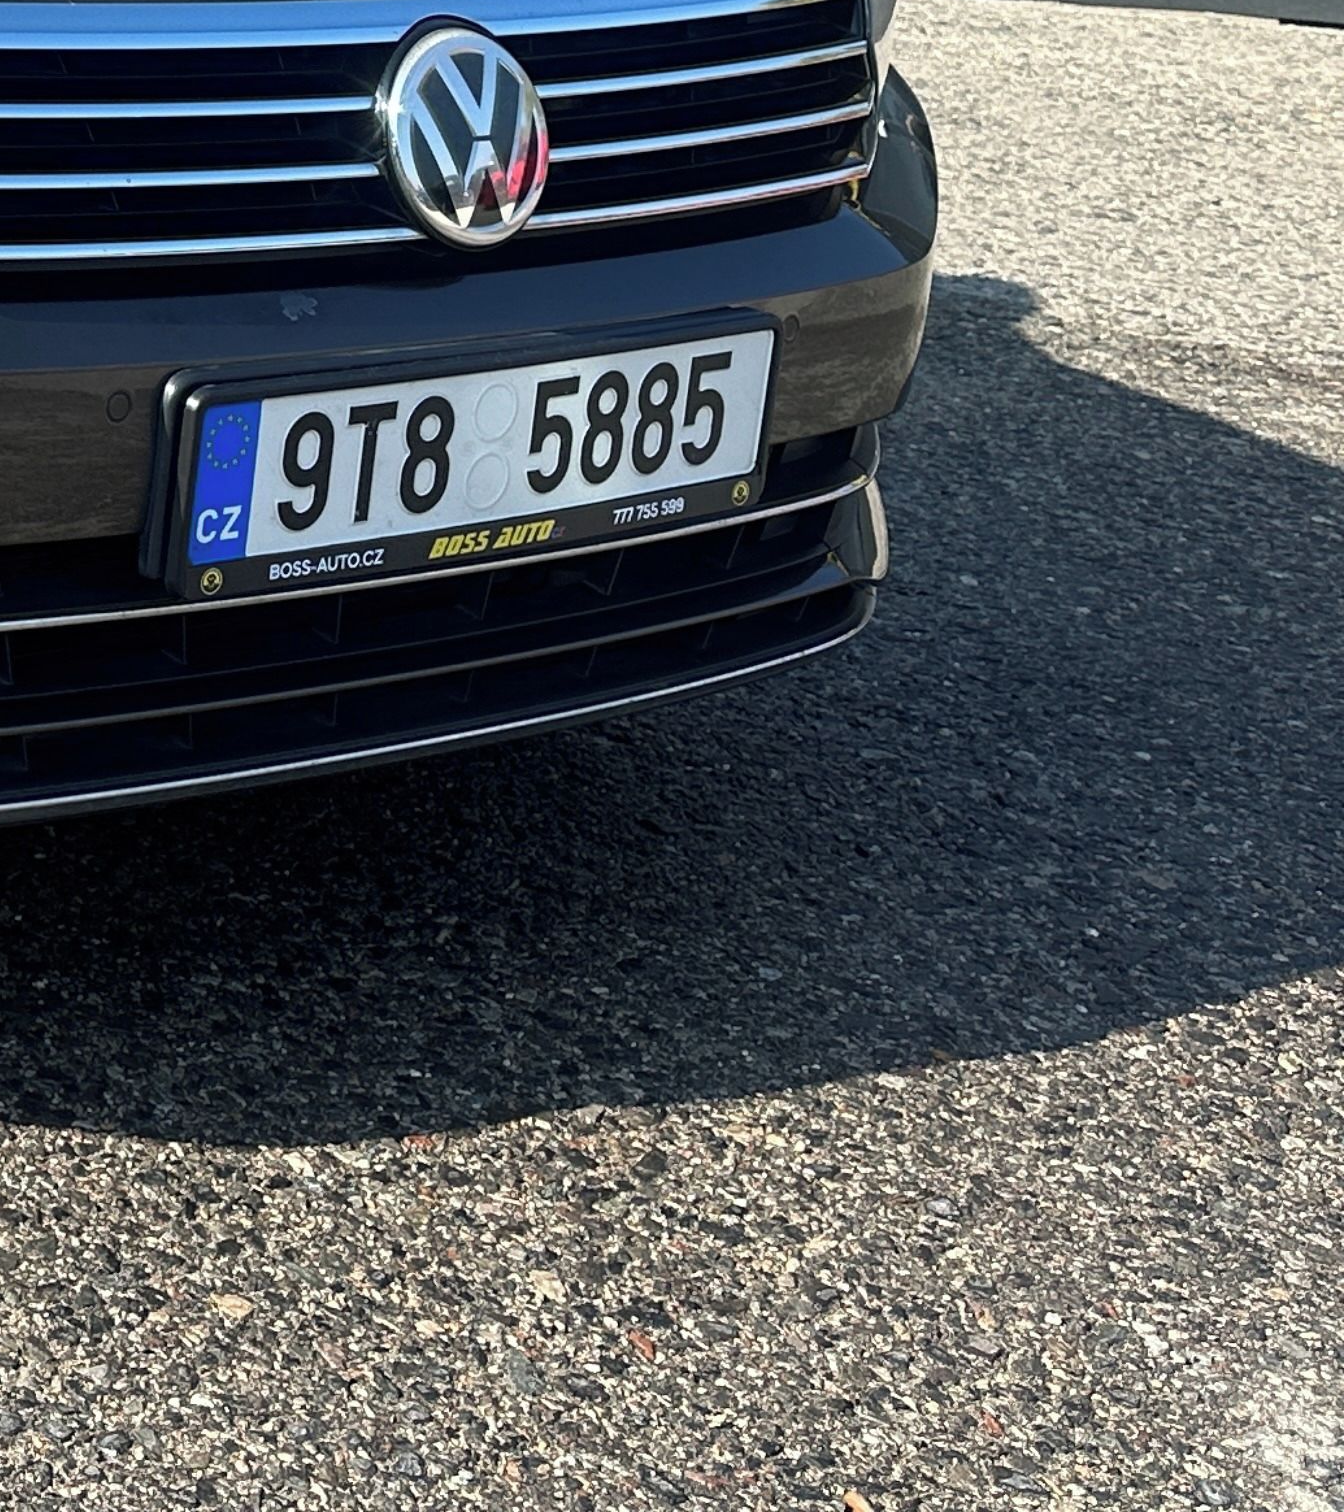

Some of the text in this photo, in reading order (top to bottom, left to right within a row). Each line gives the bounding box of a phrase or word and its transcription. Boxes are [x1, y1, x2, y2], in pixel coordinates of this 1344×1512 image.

[278, 349, 734, 532] 9T8 5885
[195, 505, 243, 545] CZ
[612, 496, 686, 526] 777 755 599
[427, 529, 491, 560] BOSS
[492, 518, 556, 550] AUTO
[268, 548, 385, 581] BOSS-AUTO.CZ
